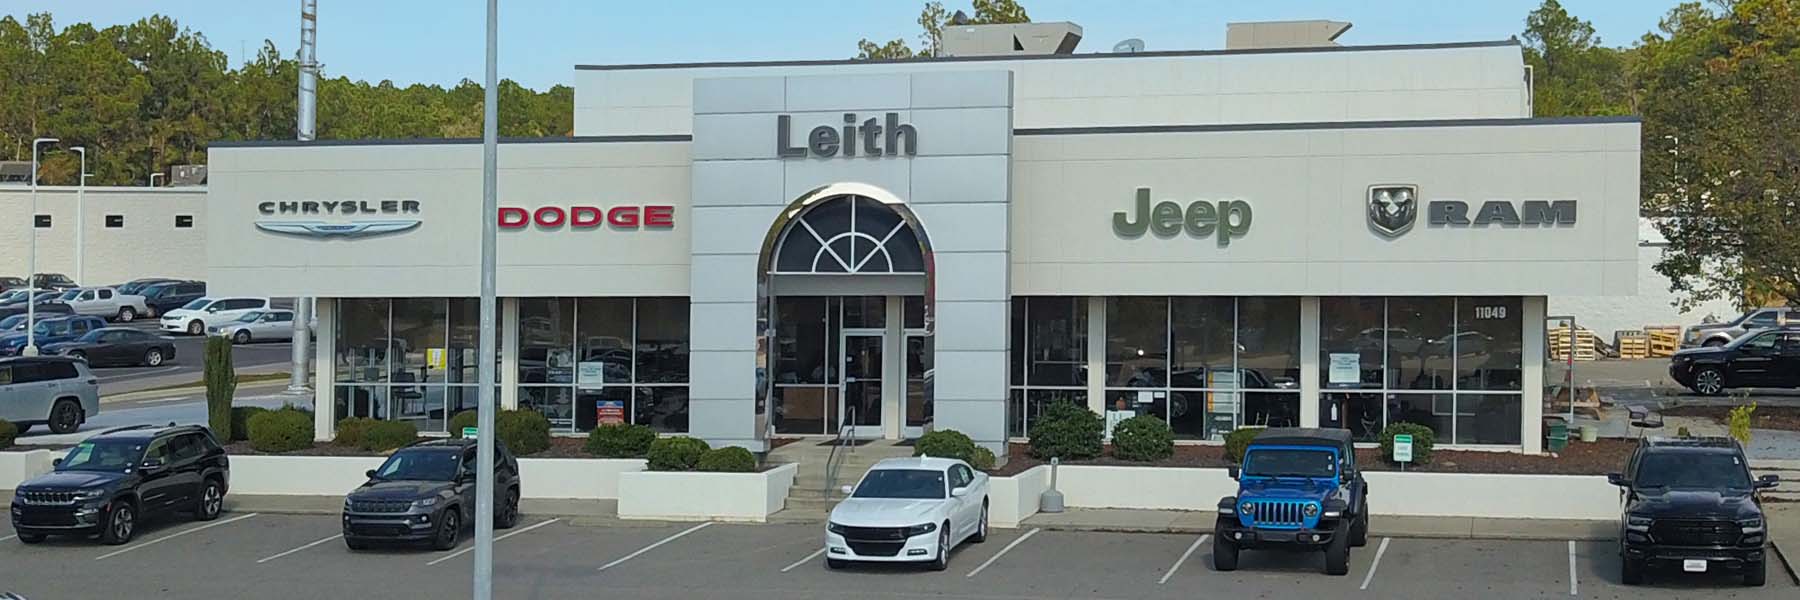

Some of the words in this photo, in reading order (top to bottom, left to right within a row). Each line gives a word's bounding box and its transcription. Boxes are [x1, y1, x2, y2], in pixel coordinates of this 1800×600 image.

[777, 113, 918, 158] Leith
[258, 200, 421, 215] CHRYSLER
[498, 205, 674, 229] DODGE
[1112, 187, 1252, 246] Jeep
[1428, 199, 1577, 227] RAM
[1475, 306, 1507, 319] 11049
